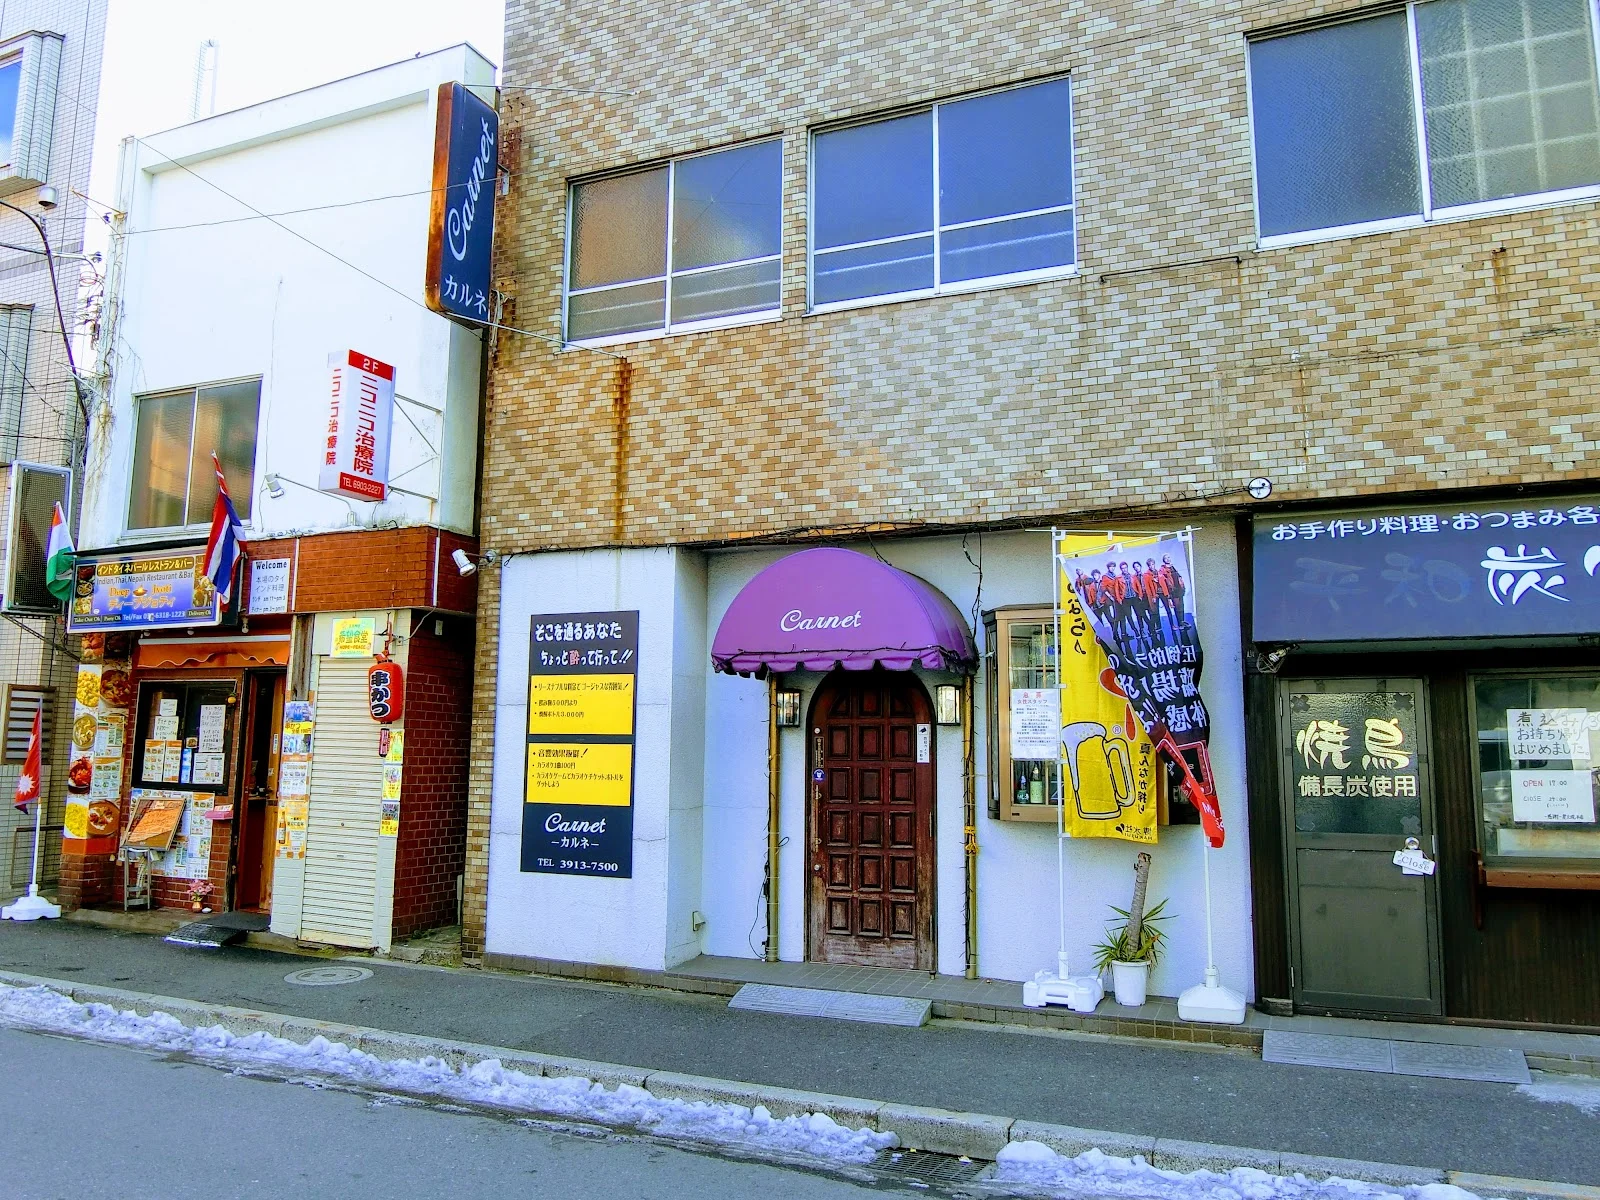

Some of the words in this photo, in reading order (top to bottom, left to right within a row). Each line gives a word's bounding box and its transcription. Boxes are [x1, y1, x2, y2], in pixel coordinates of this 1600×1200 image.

[448, 117, 494, 262] Carnet
[444, 274, 487, 315] カルネ
[363, 358, 379, 373] 2F
[326, 368, 342, 466] ニコニコ治療院
[354, 375, 379, 476] ニコニコ治療院
[342, 477, 352, 488] TEL
[1272, 504, 1600, 541] お手作り料理・おつまみ各
[256, 560, 288, 570] Welcome
[1480, 544, 1600, 606] 炭
[146, 572, 178, 582] Restaurant
[535, 622, 622, 642] そこを通るあなた
[780, 609, 861, 632] Carnet
[370, 670, 390, 718] 串かつ
[1296, 718, 1413, 770] 焼鳥
[1516, 728, 1580, 741] お持ち帰り
[1298, 774, 1417, 798] 備長炭使用
[545, 812, 606, 833] Carnet
[538, 858, 554, 866] TEL
[560, 860, 618, 872] 3913-7500
[1402, 856, 1429, 871] Close
